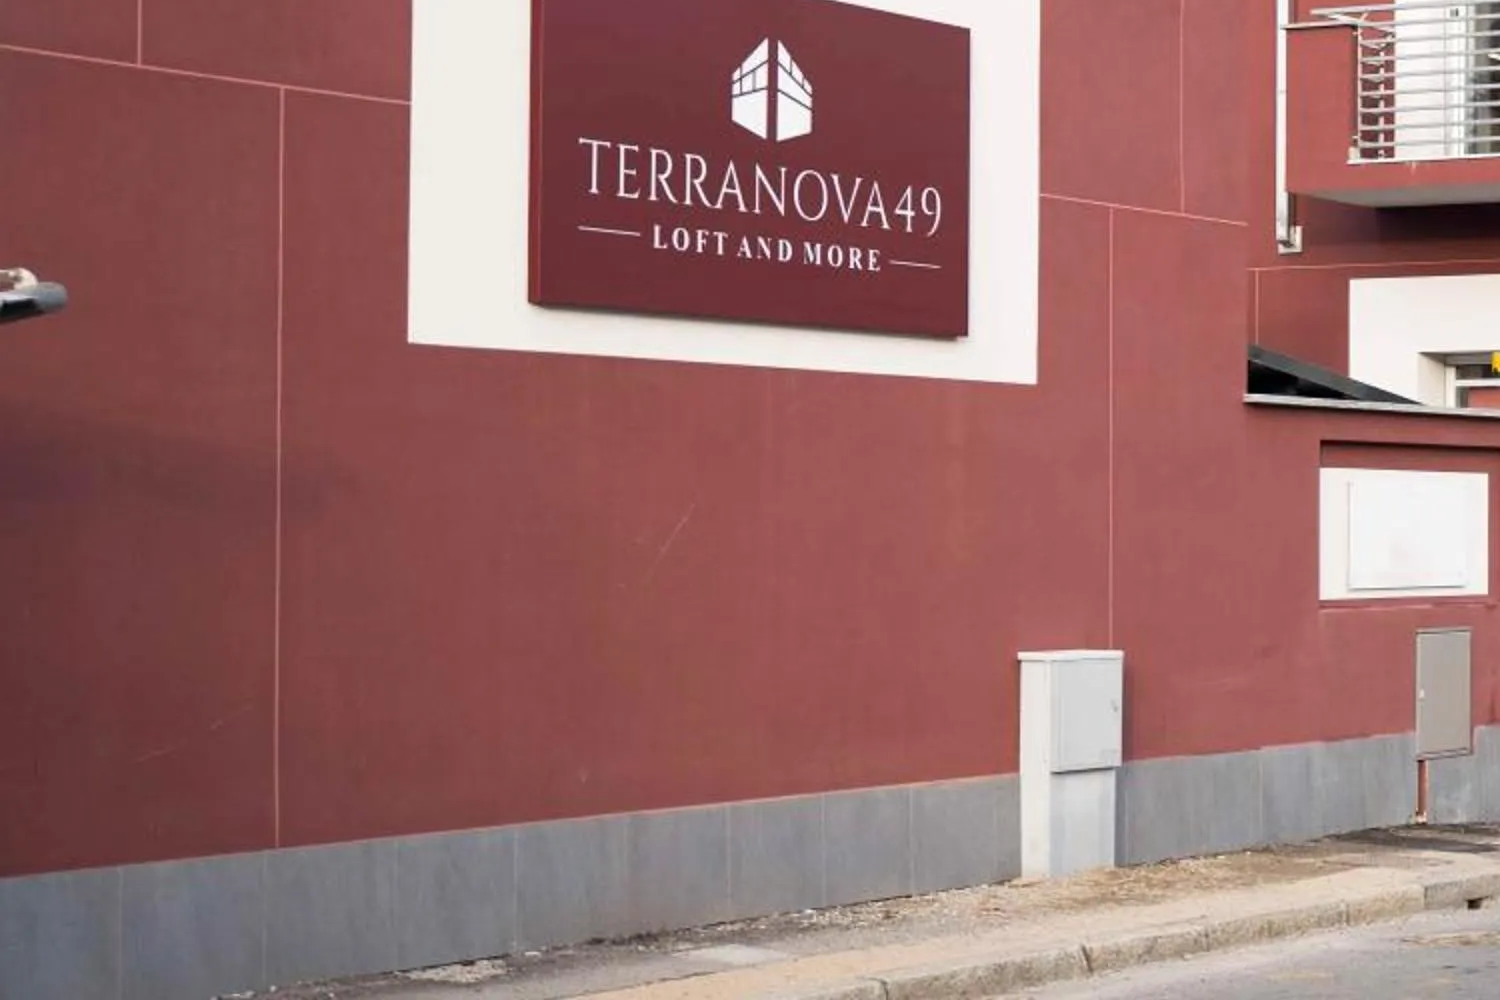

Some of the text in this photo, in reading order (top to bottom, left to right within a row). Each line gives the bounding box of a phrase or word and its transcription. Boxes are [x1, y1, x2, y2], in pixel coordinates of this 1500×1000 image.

[578, 137, 942, 237] TERRANOVA49
[653, 223, 882, 272] LOFT AND MORE
